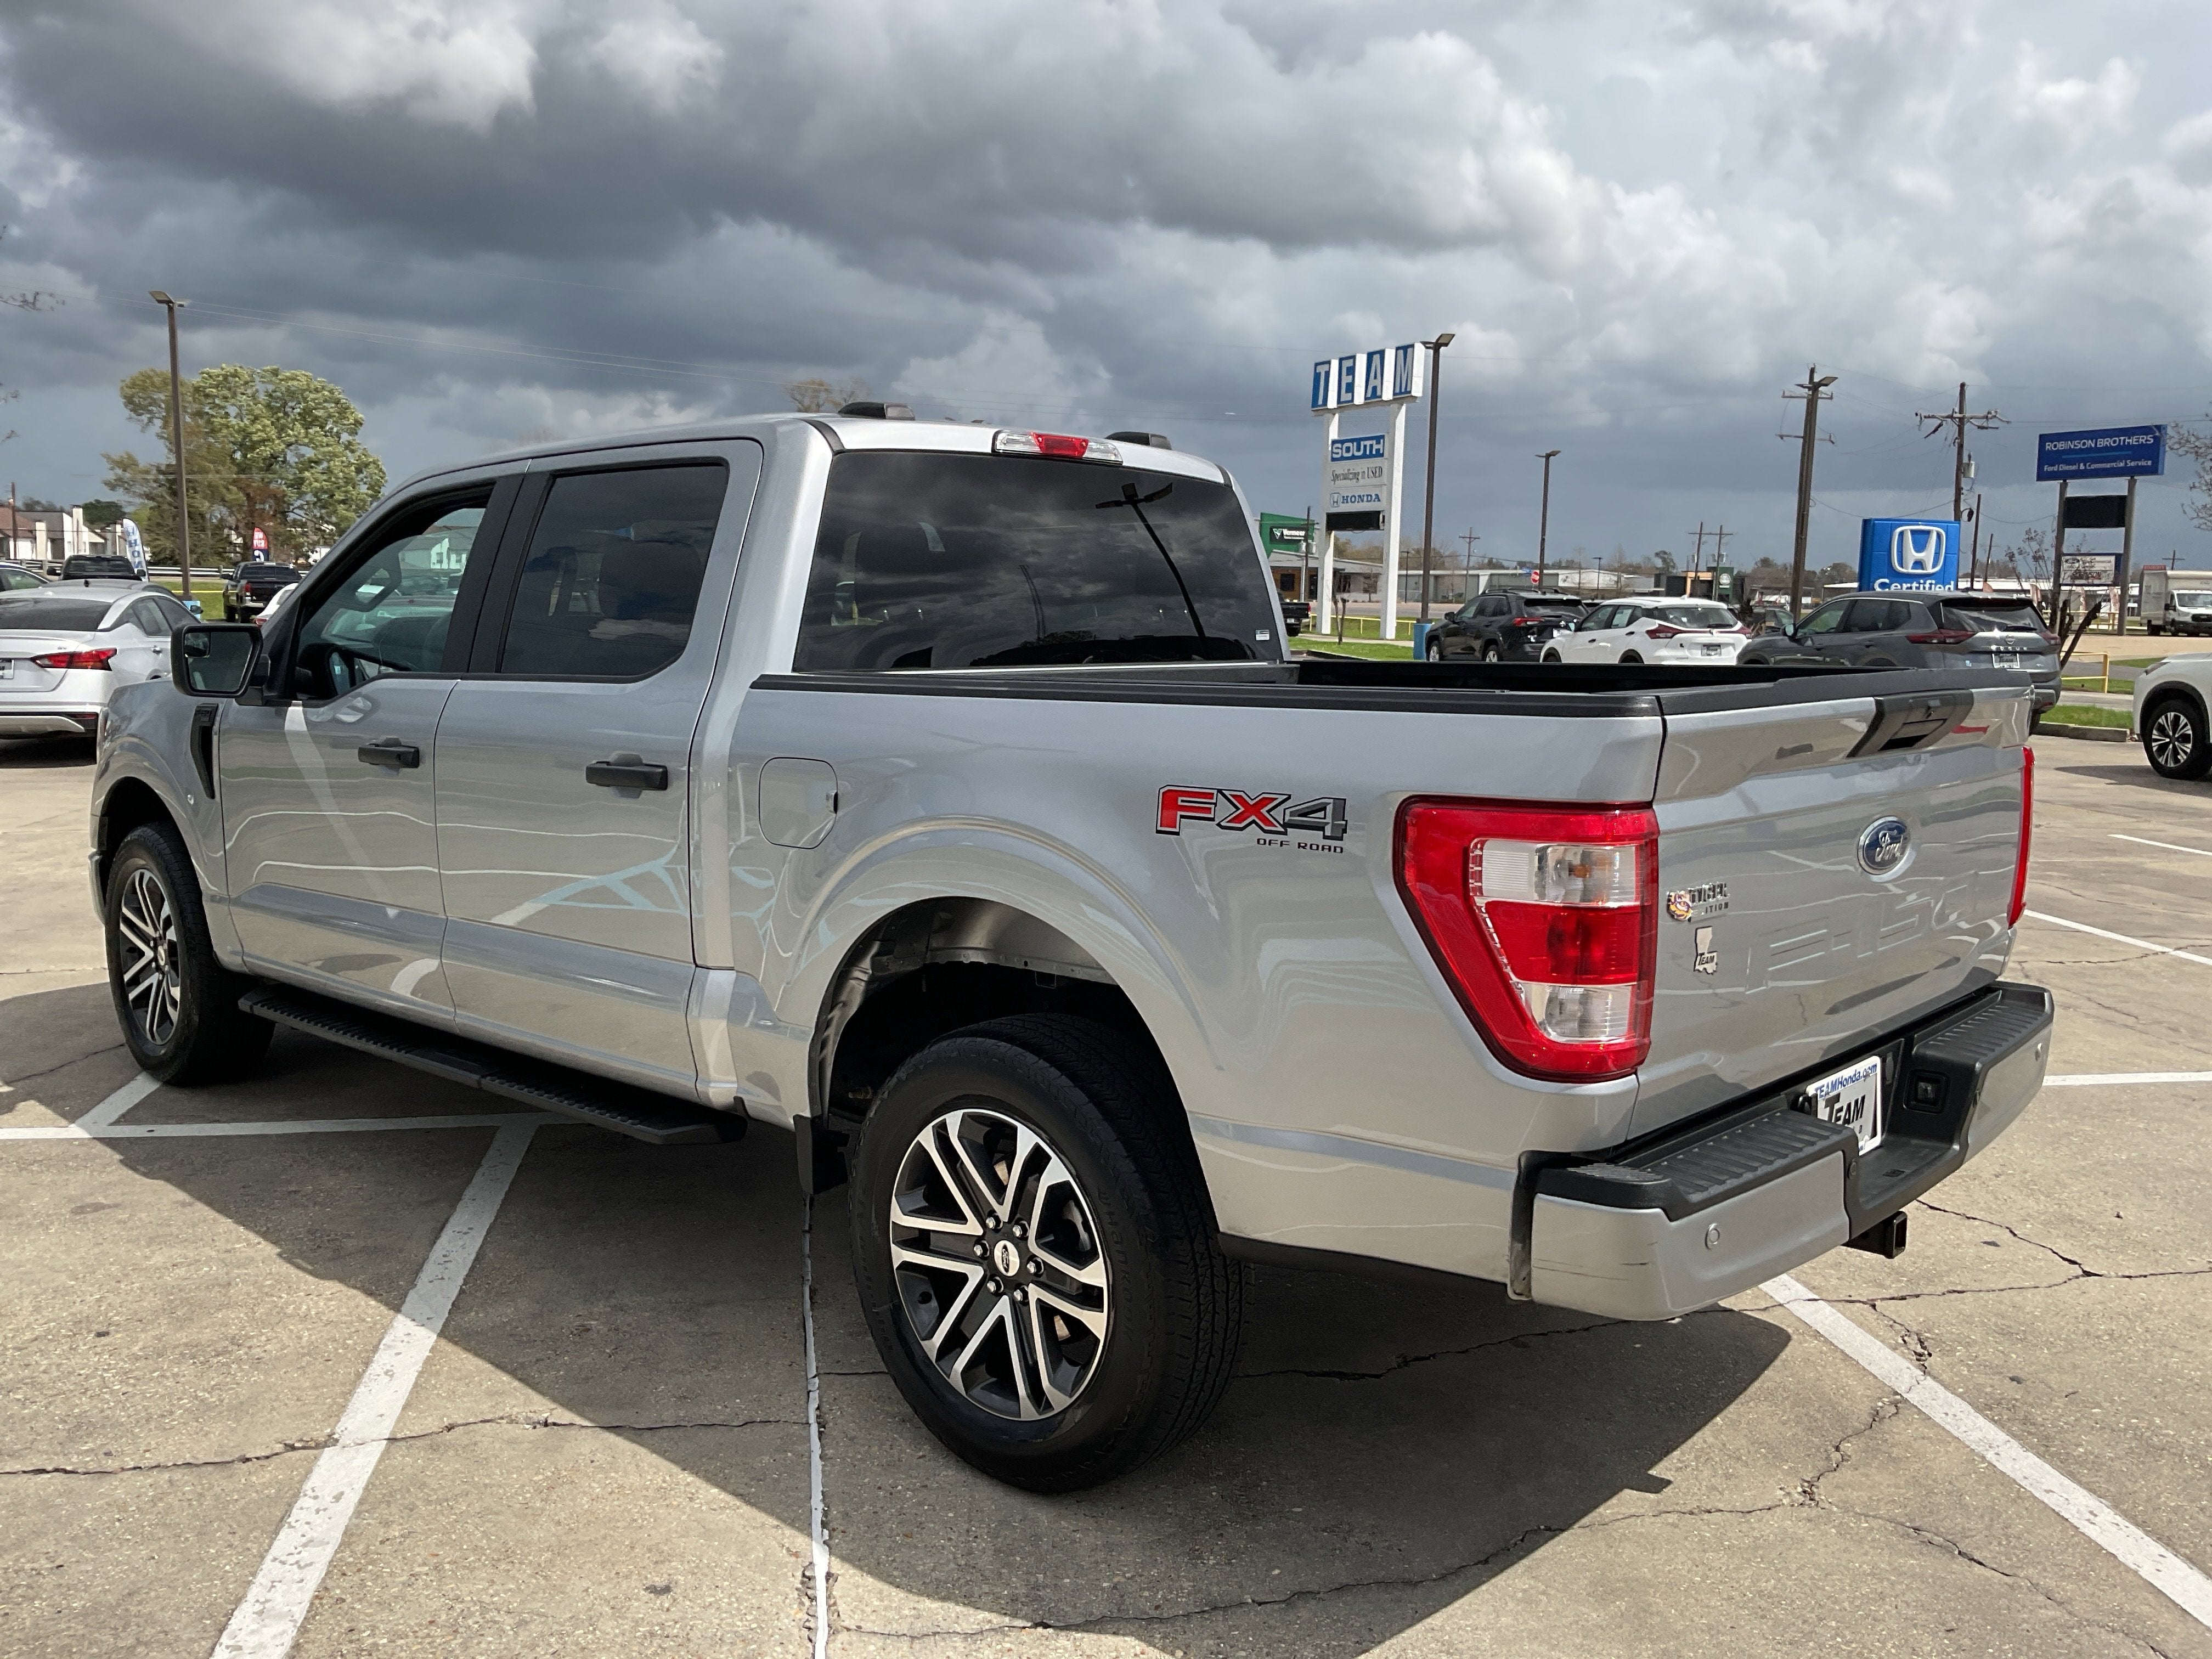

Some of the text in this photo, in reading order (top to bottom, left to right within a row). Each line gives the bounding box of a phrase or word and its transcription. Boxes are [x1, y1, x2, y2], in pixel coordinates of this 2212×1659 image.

[1317, 347, 1414, 405] TEAM
[1332, 439, 1384, 458] SOUTH
[2046, 435, 2154, 450] ROBINSON BROTHERS
[1367, 466, 1383, 479] USED
[2086, 460, 2125, 469] Commercial
[1341, 494, 1381, 504] HONDA
[1874, 579, 1954, 591] Certified
[1156, 785, 1348, 841] FX4
[1257, 838, 1344, 854] OFF ROAD
[1875, 829, 1903, 862] Ford
[1687, 882, 1730, 904] TIGER
[1698, 952, 1715, 966] TEAM
[1824, 1092, 1866, 1125] TEAM
